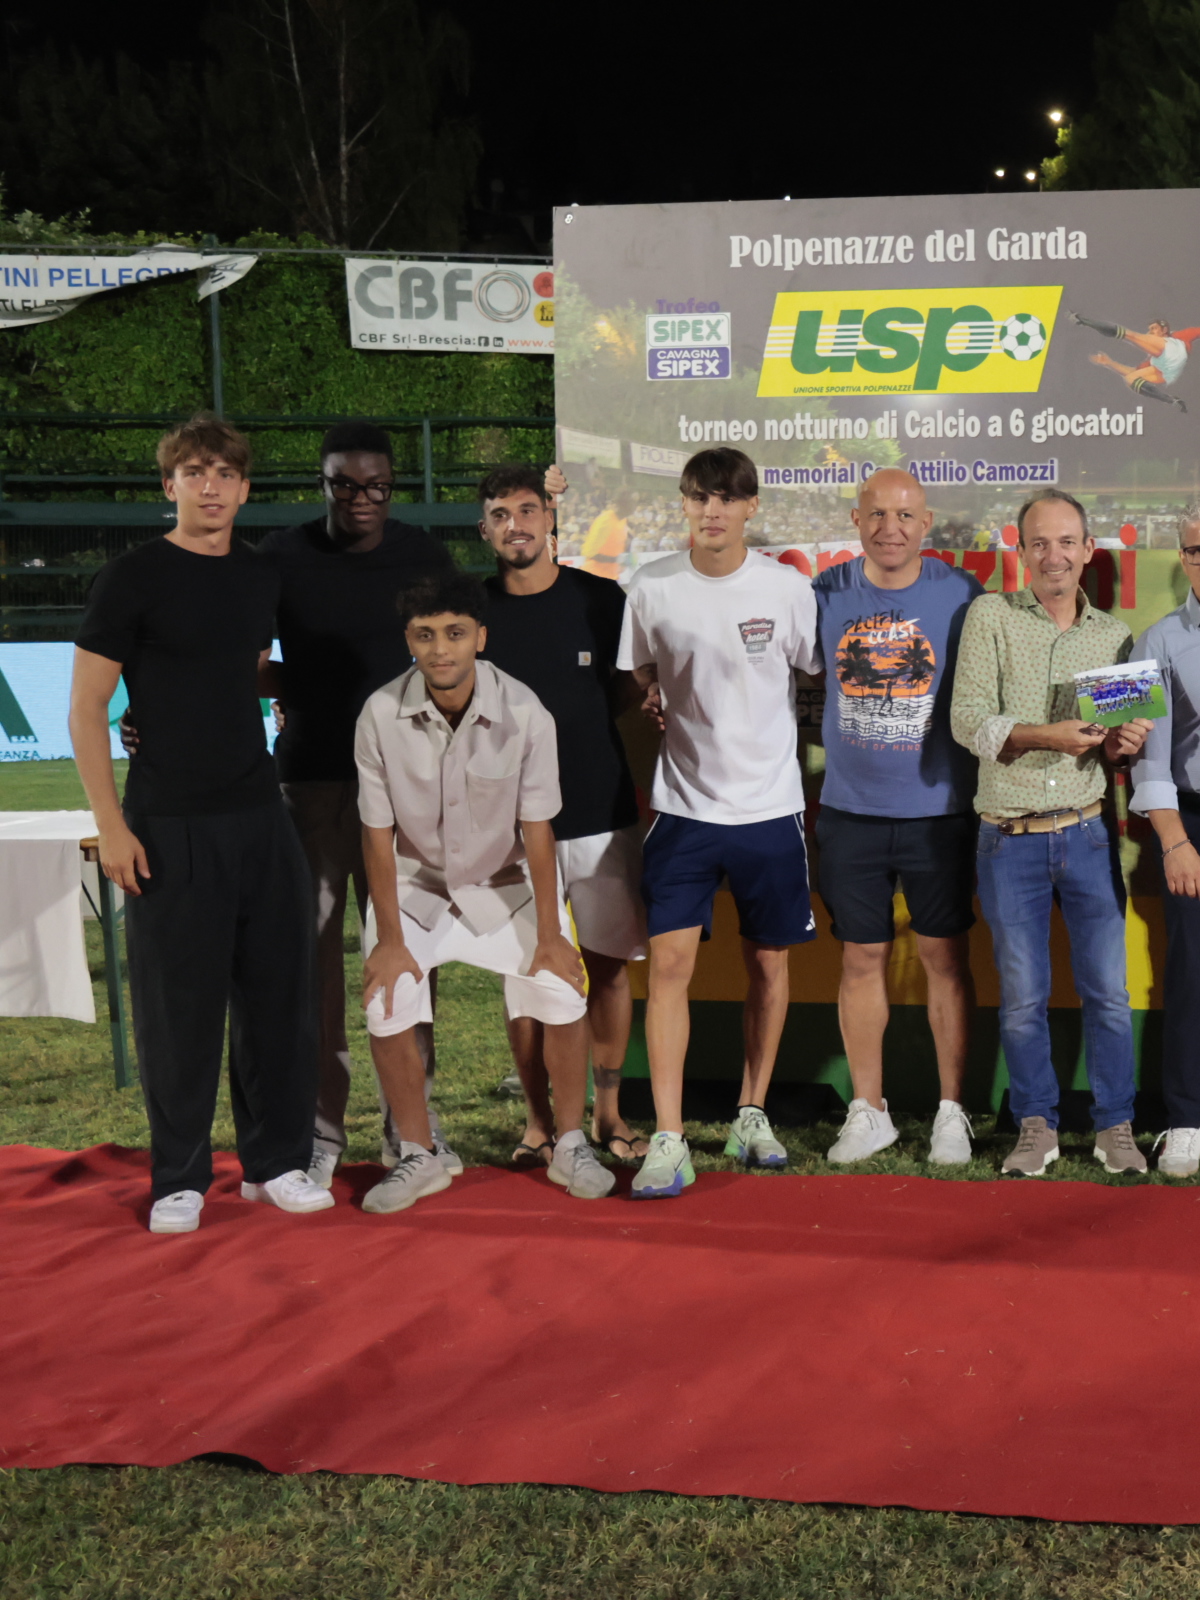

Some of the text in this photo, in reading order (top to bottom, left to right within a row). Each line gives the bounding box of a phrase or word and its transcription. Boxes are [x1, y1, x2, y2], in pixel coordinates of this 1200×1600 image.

[729, 226, 1088, 271] Polpenazze del Garda
[0, 266, 39, 287] INI
[49, 266, 192, 287] PELLEG
[354, 265, 474, 321] CBF
[655, 297, 721, 314] Trofeo
[358, 333, 387, 343] CBF
[653, 319, 722, 342] SIPEX
[656, 349, 720, 360] CAVAGNA
[656, 359, 720, 376] SIPEX
[793, 386, 824, 394] UNIONE
[826, 385, 861, 393] SPORTIVA
[678, 406, 1144, 443] torneo notturno di Calcio a 6 giocatori
[763, 462, 855, 485] memorial
[908, 459, 967, 483] Attilio
[972, 459, 1055, 482] Camozzi
[741, 622, 772, 632] Paradise
[842, 608, 906, 634] PACIFIC
[746, 631, 769, 643] hotel
[867, 617, 921, 645] COAST
[0, 750, 41, 760] ANZA
